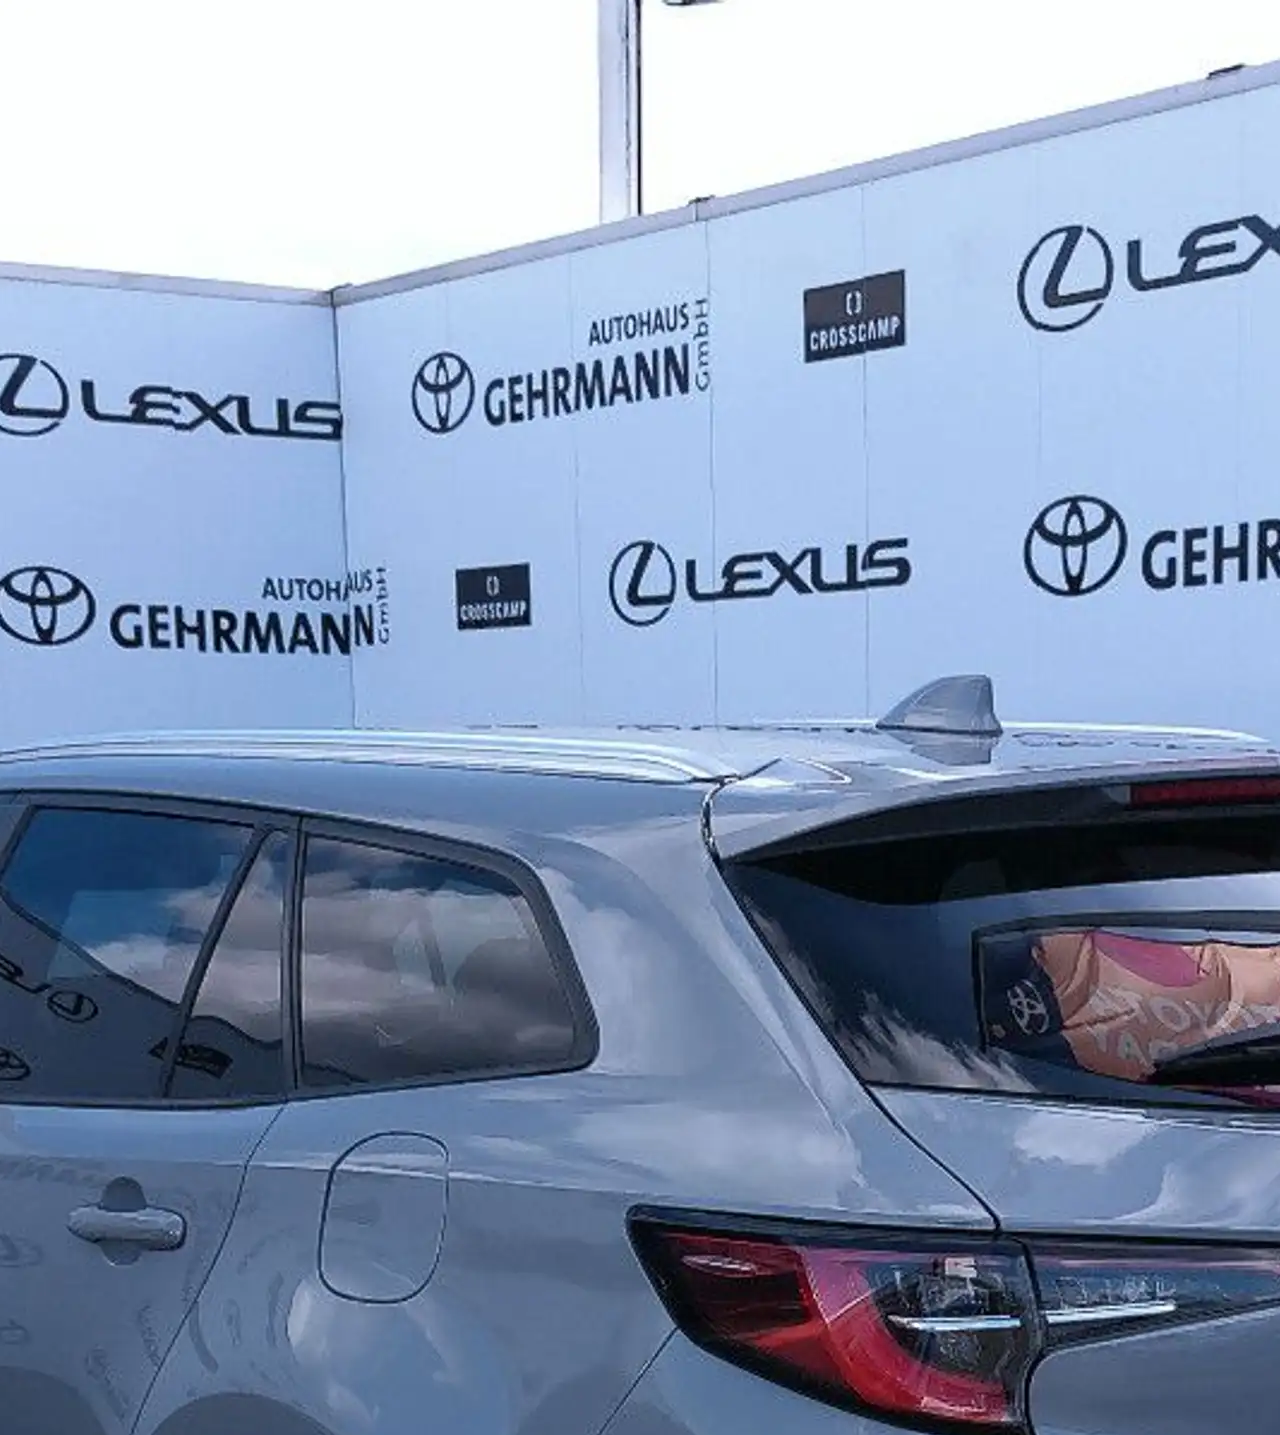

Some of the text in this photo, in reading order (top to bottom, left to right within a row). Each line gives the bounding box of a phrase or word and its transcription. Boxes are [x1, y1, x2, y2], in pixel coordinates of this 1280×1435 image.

[588, 302, 690, 347] AUTOHAUS
[810, 315, 900, 351] CROSSCAMP
[80, 379, 343, 441] LEXUS
[483, 342, 690, 427] GEHRMANN
[261, 569, 373, 602] AUTOHAUS
[685, 537, 912, 602] LEXUS
[109, 603, 375, 656] GEHRMANN
